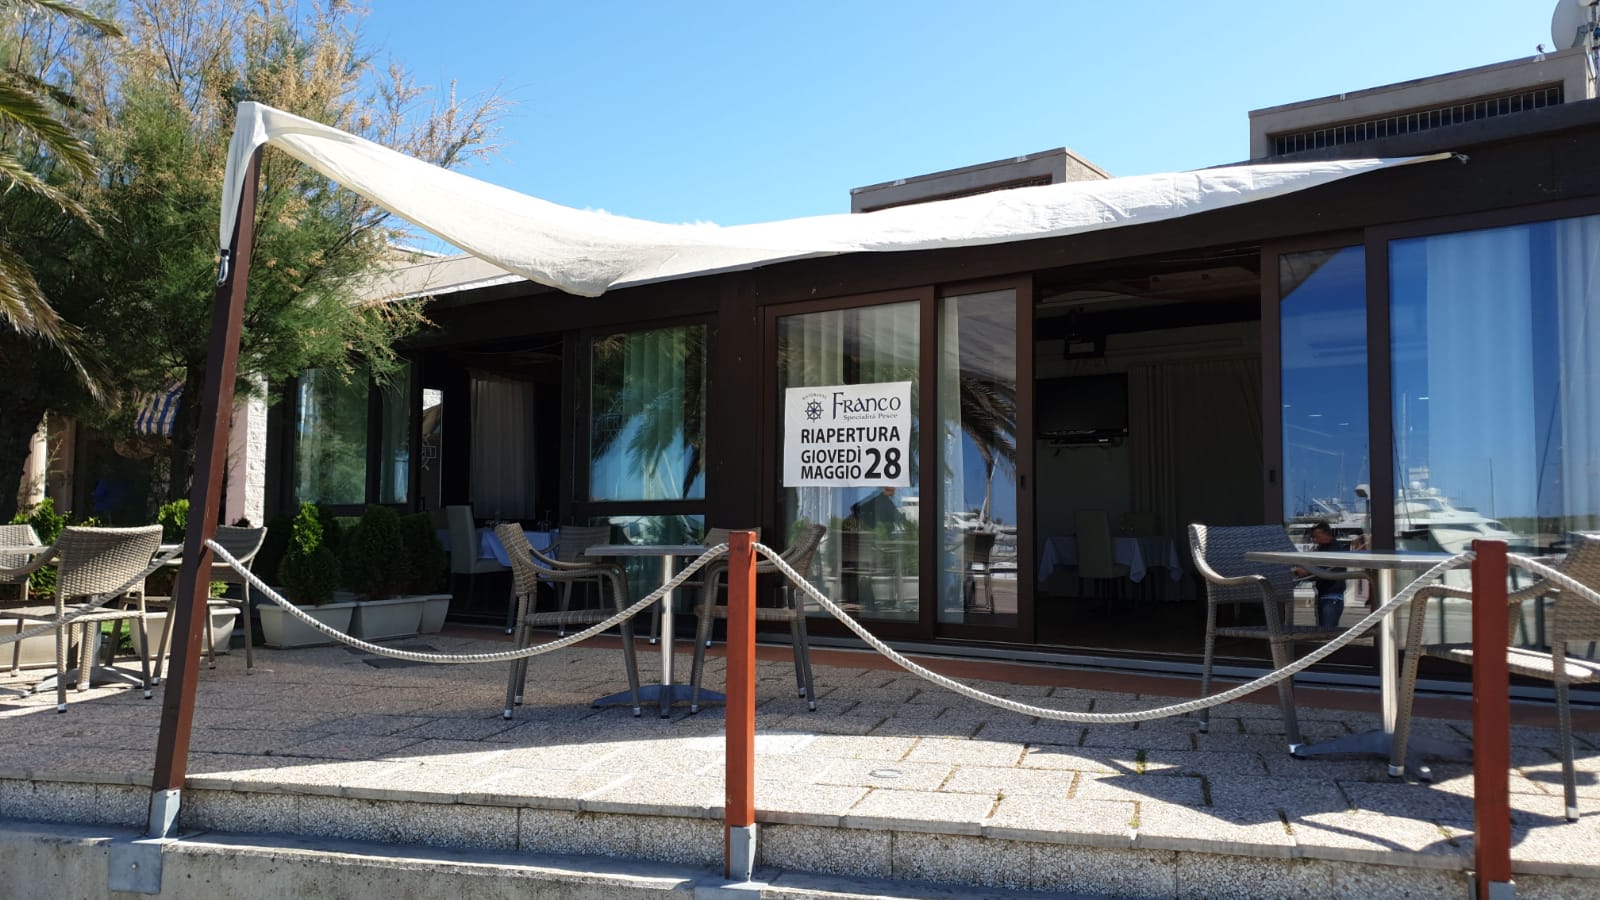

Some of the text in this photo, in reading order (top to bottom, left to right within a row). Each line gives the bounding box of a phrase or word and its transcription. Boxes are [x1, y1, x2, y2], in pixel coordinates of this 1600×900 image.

[801, 426, 900, 444] RIAPERTURA
[801, 446, 901, 479] GIOVEDÌ 28
[801, 465, 862, 479] MAGGIO
